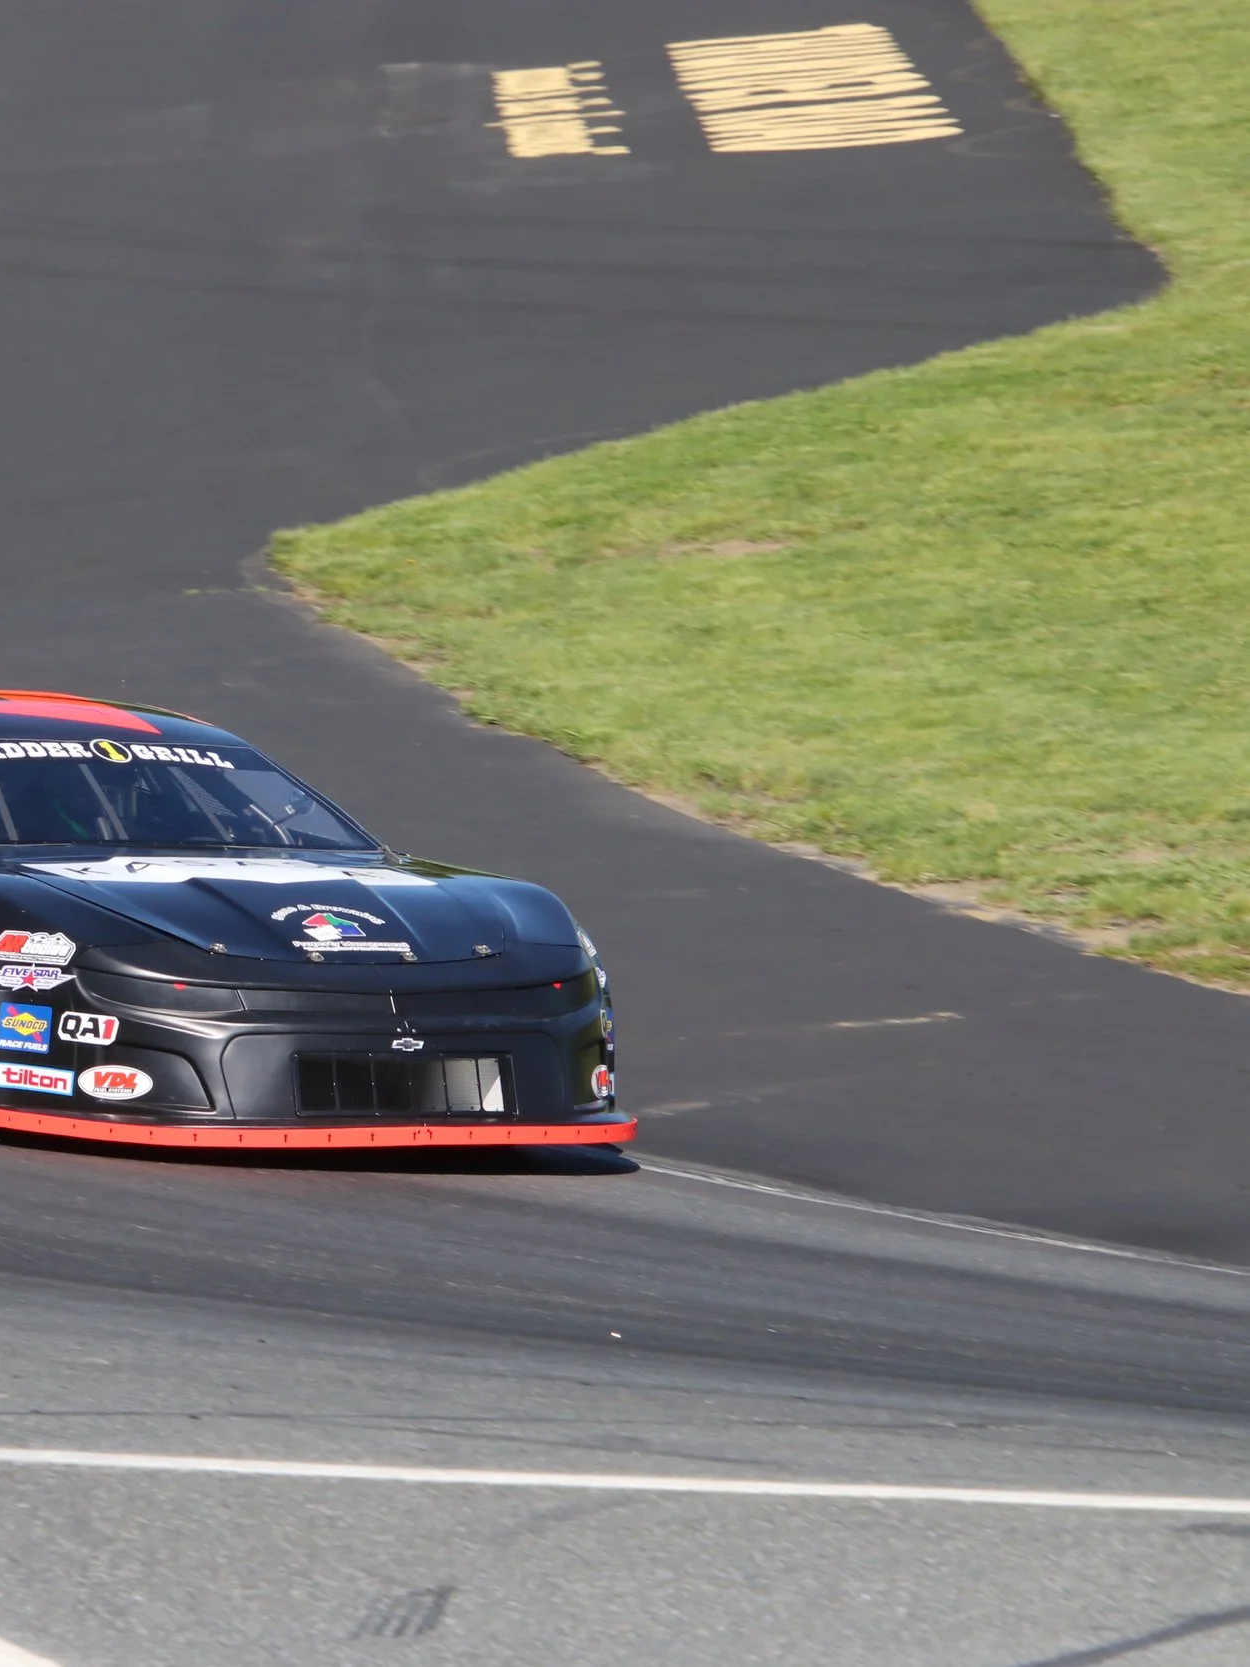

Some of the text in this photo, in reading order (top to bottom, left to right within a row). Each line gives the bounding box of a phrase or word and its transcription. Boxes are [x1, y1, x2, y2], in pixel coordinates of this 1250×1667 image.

[664, 23, 964, 153] THUNDER ROAD
[98, 741, 125, 762] 1
[130, 744, 236, 769] GRILL
[2, 968, 59, 980] FIVE STAR
[3, 1018, 47, 1033] SUNOCO
[61, 1014, 116, 1040] QA1
[23, 1041, 48, 1052] FUELS
[2, 1066, 67, 1090] tilton
[94, 1071, 138, 1088] VDL
